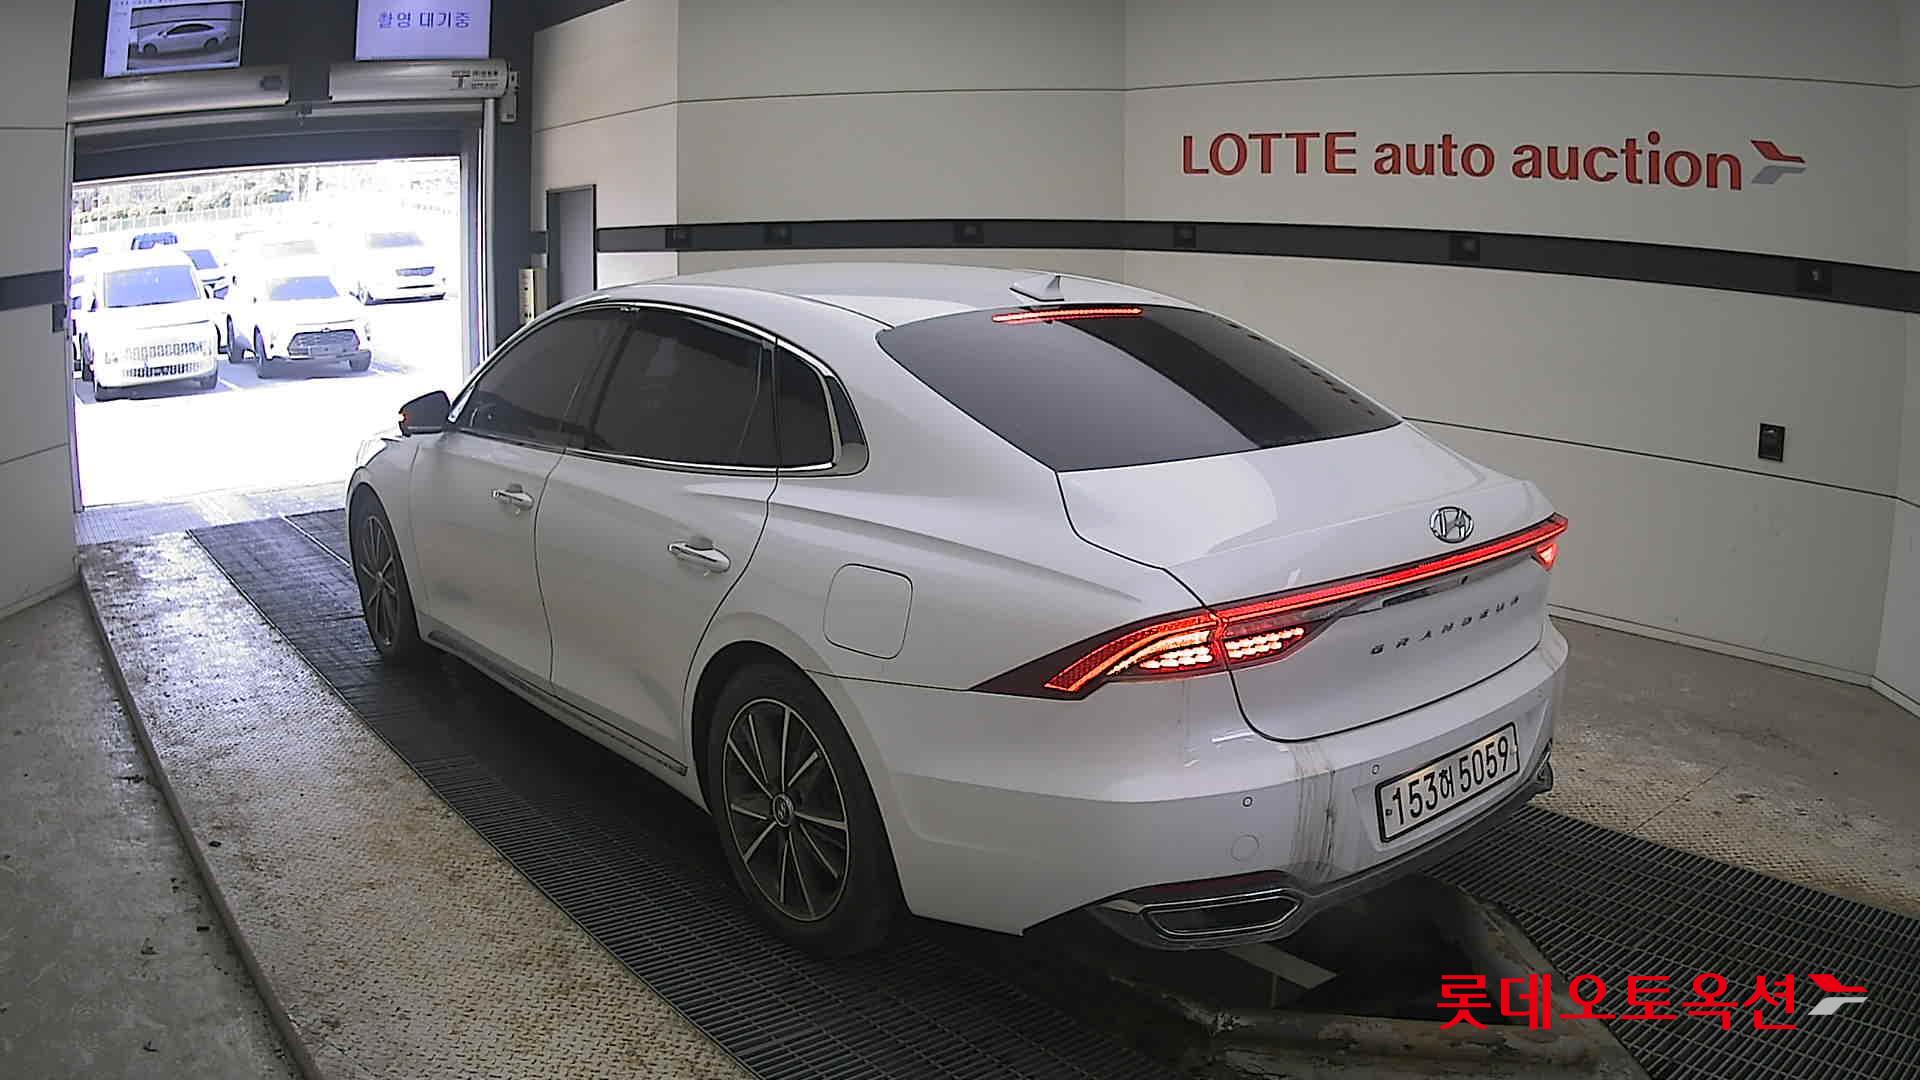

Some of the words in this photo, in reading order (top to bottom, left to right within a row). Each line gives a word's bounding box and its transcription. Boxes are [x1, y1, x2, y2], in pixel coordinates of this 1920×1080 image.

[419, 11, 471, 29] 대기중
[1182, 131, 1358, 177] LOTTE
[1374, 134, 1496, 178] auto
[1511, 130, 1743, 191] auction
